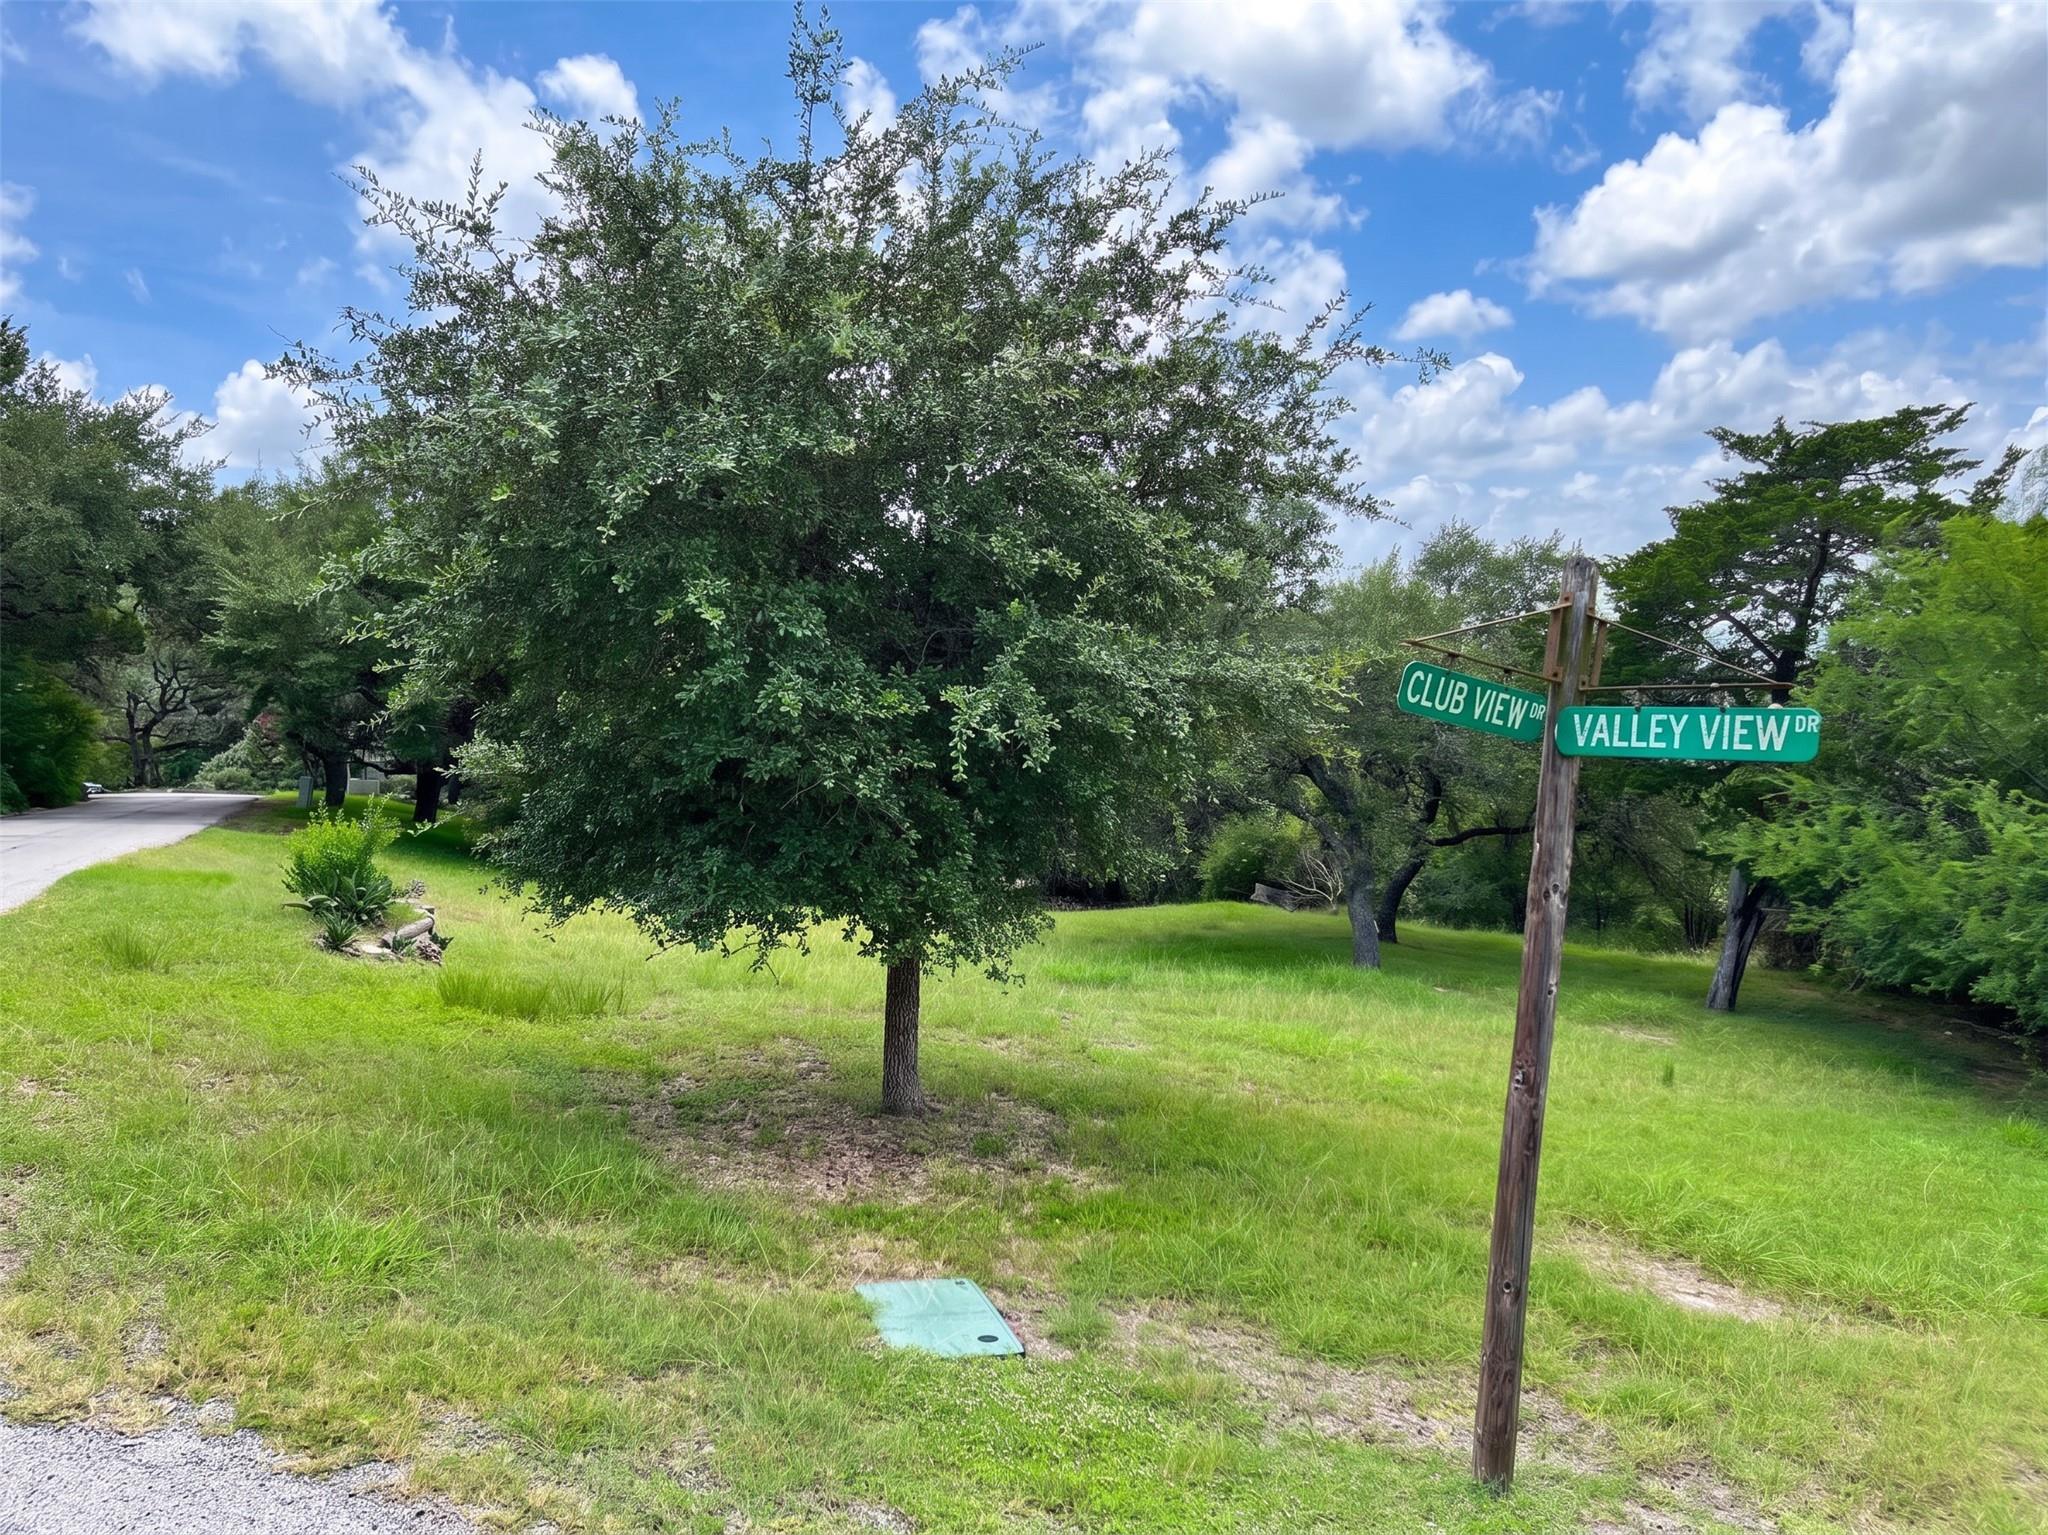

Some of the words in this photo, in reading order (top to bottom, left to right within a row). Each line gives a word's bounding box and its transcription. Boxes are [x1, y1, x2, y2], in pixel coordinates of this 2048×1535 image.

[1407, 670, 1468, 714] CLUB
[1474, 686, 1529, 730] VIEW
[1529, 702, 1546, 720] DR
[1573, 714, 1689, 749] VALLEY
[1699, 714, 1790, 751] VIEW
[1794, 715, 1820, 733] DR
